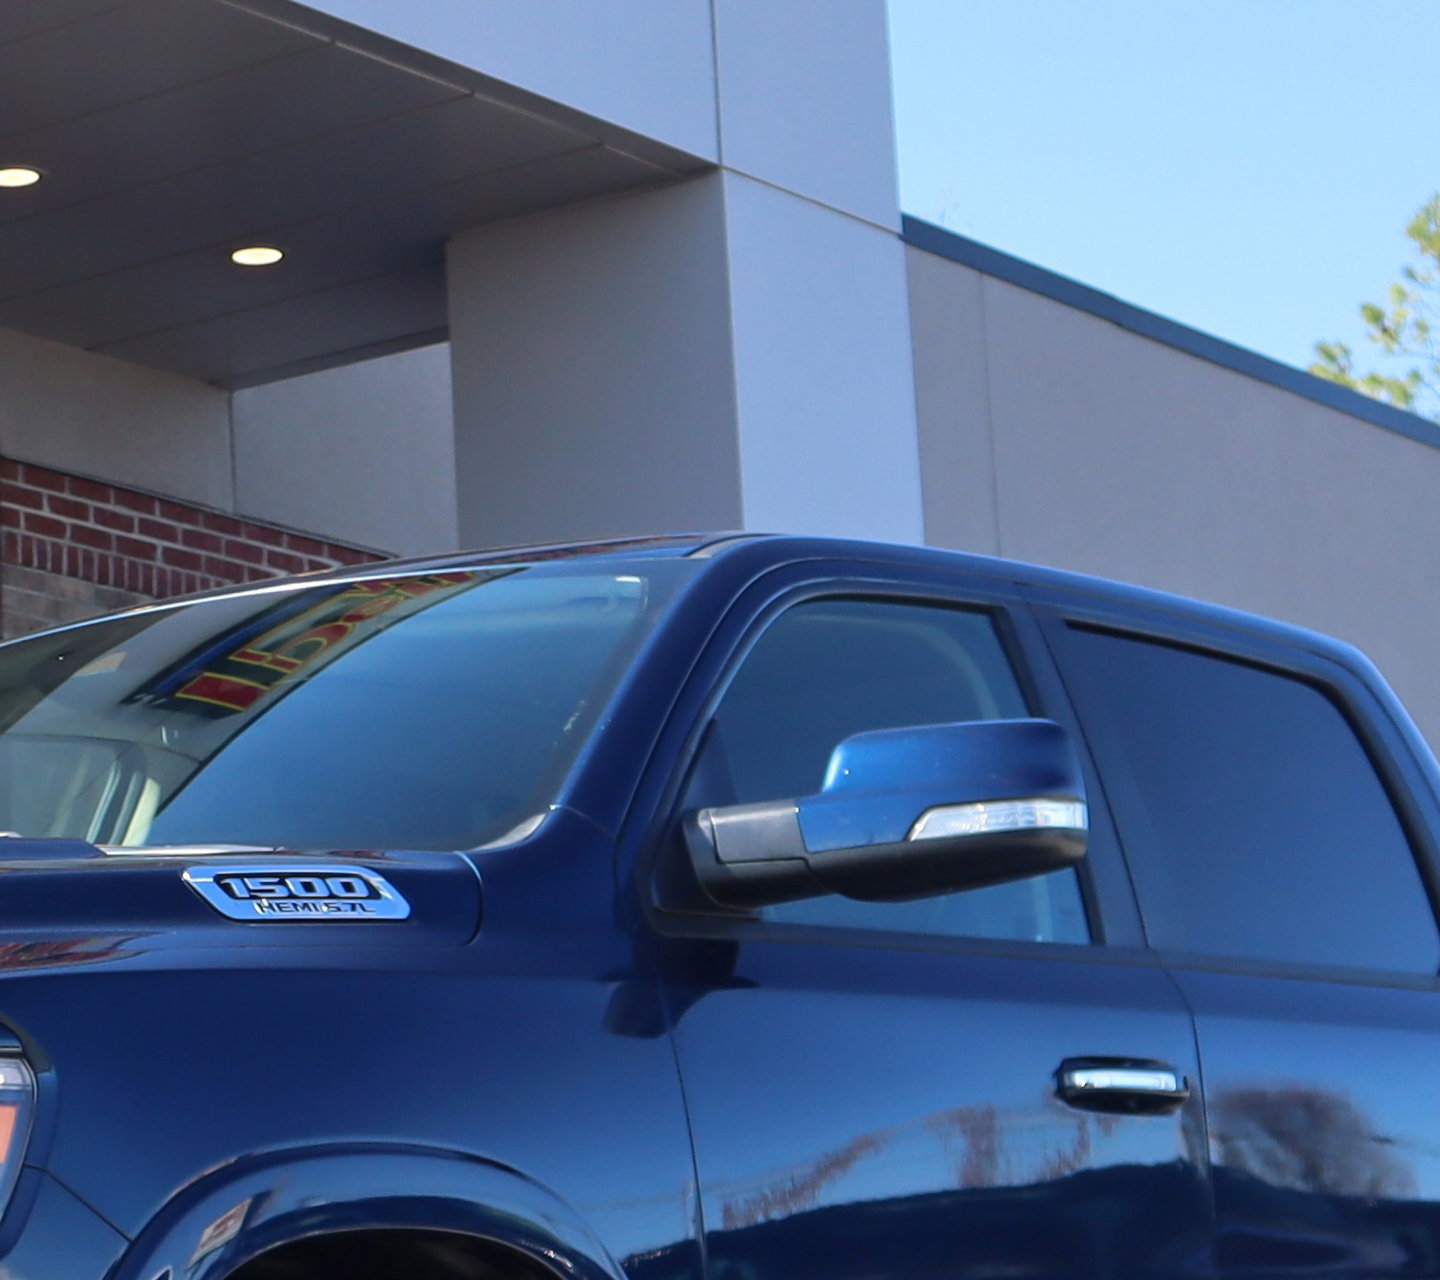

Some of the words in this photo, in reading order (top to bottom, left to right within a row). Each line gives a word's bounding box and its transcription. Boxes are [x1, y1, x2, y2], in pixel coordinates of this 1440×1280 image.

[220, 876, 371, 899] 1500
[254, 900, 322, 914] HEMI
[324, 901, 377, 914] 5.7L
